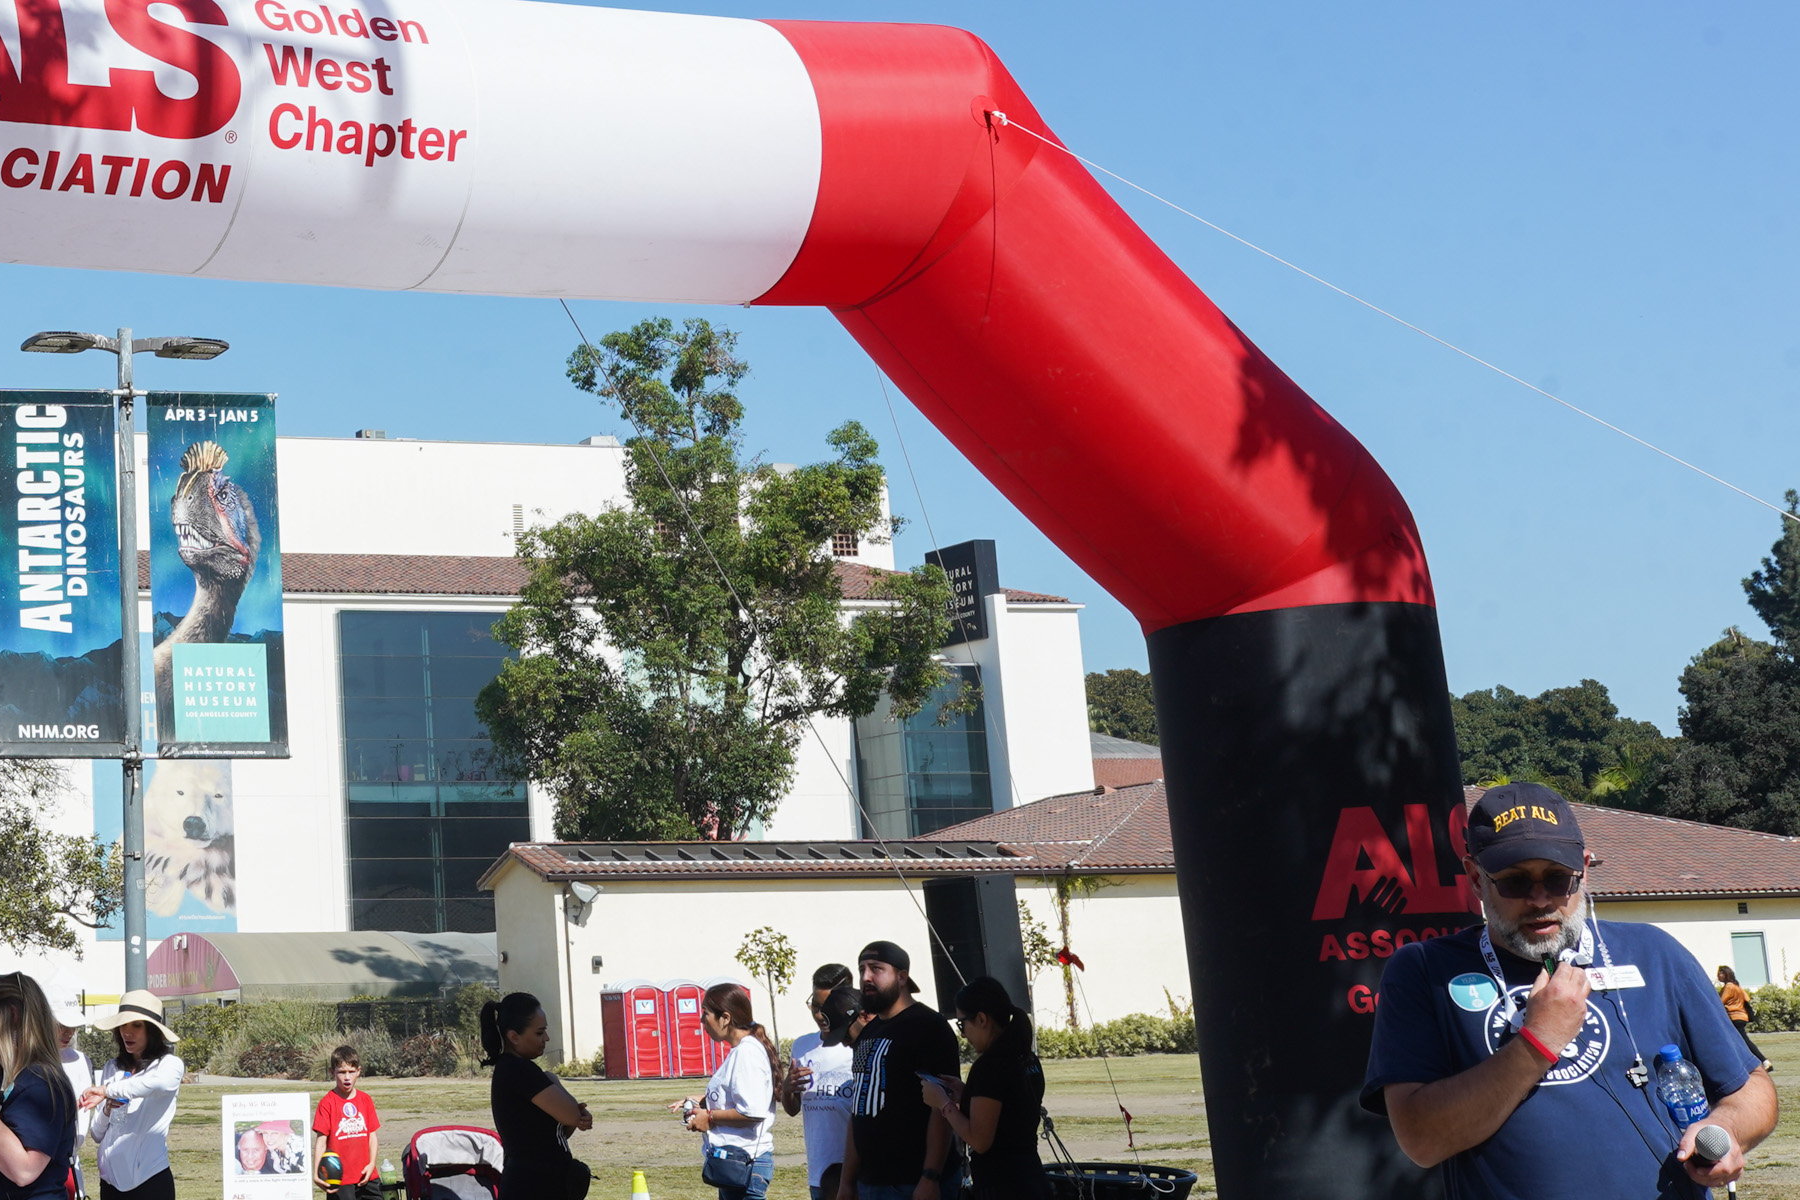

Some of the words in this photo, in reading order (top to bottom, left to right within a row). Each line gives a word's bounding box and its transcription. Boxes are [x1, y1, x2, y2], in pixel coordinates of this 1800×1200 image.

[262, 43, 394, 96] West
[268, 102, 468, 167] Chapter
[165, 408, 195, 421] APR
[198, 409, 206, 421] 3
[219, 410, 247, 425] JAN
[250, 410, 259, 422] 5
[15, 405, 73, 634] ANTARCTIC
[63, 432, 88, 596] DINOSAURS
[947, 565, 972, 580] URAL
[184, 666, 256, 677] NATURAL
[184, 681, 257, 692] HISTORY
[185, 696, 257, 706] MUSEUM
[18, 724, 100, 739] NHM.ORG
[1493, 806, 1526, 833] BEAT
[1531, 806, 1558, 826] ALS
[1460, 976, 1477, 984] YEAR
[1469, 984, 1479, 999] 4
[1546, 1040, 1602, 1080] SSOCIATION
[816, 1085, 854, 1098] HERO
